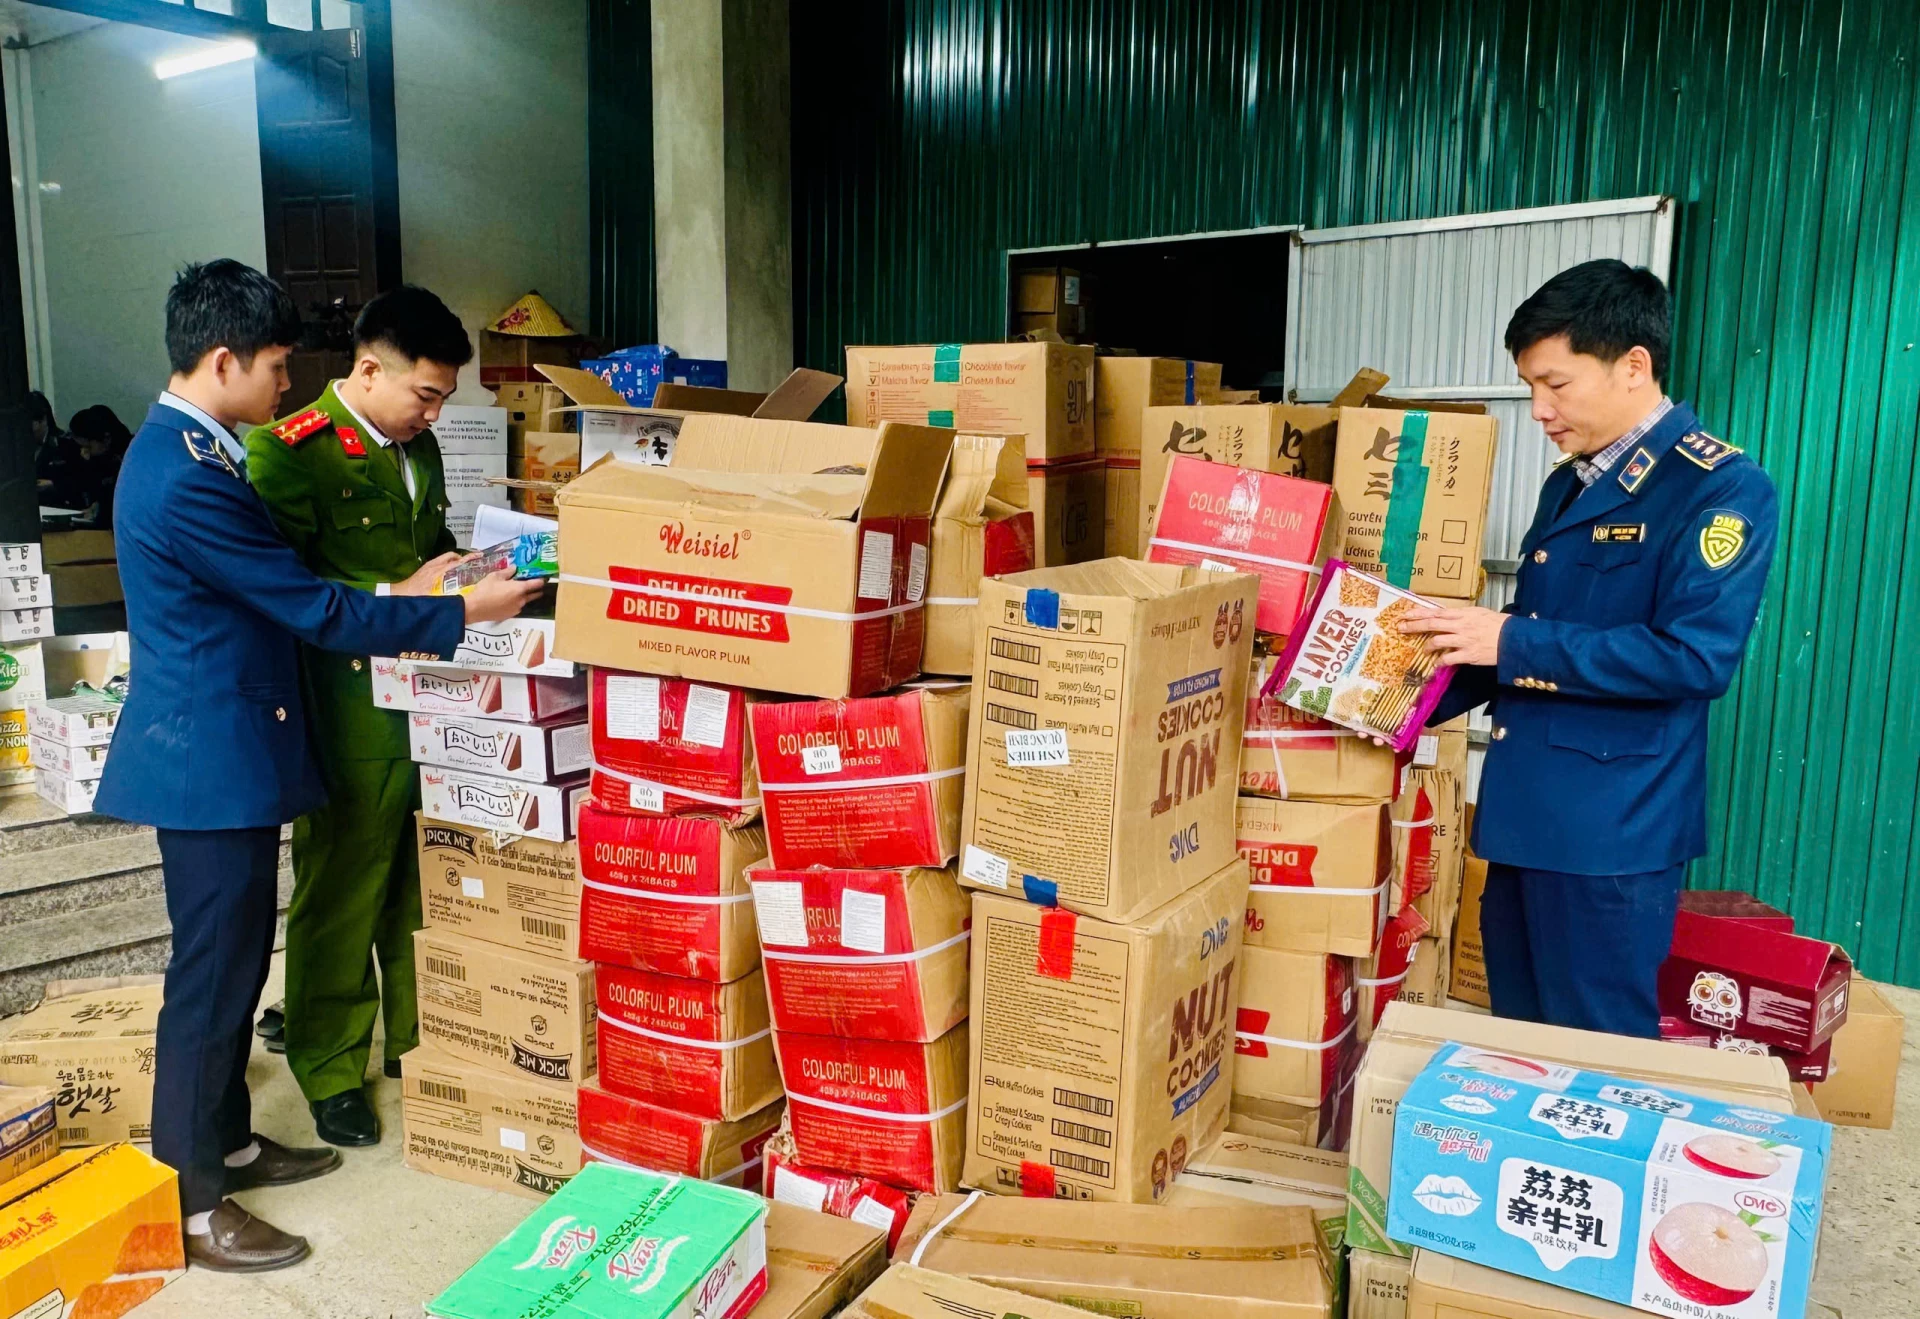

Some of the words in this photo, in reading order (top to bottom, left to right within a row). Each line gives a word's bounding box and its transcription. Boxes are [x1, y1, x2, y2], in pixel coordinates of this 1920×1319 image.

[1261, 507, 1303, 533] PLUM
[1348, 511, 1382, 523] GUYÊN
[1713, 515, 1743, 531] DMS
[1347, 526, 1385, 538] RIGINA
[623, 596, 680, 621] DRIED
[695, 606, 771, 633] PRUNES
[466, 635, 507, 651] いしい
[638, 639, 672, 653] MIXED
[675, 645, 717, 660] FLAVOR
[720, 652, 750, 666] PLUM
[1297, 608, 1353, 679] LAVER
[1325, 617, 1367, 684] COOKIES
[420, 677, 468, 697] おいしい
[1158, 692, 1224, 743] COOKIES
[451, 731, 492, 752] おいしい
[778, 730, 853, 755] COLORFUL
[857, 726, 900, 750] PLUM
[841, 756, 882, 767] 4BAGS
[1039, 749, 1065, 761] ANH
[1151, 727, 1221, 818] NUT
[465, 790, 508, 812] おいしい
[1246, 820, 1283, 832] MIXED
[453, 834, 471, 850] ME
[594, 842, 656, 871] COLORFUL
[659, 852, 697, 876] PLUM
[1240, 847, 1299, 866] DRIED
[608, 982, 665, 1014] COLORFUL
[668, 996, 704, 1020] PLUM
[1398, 990, 1425, 1003] ARE
[1169, 957, 1235, 1063] NUT
[518, 1051, 535, 1070] ME
[1167, 1026, 1227, 1097] COOKIES
[802, 1058, 866, 1085] COLORFUL
[869, 1066, 906, 1090] PLUM
[524, 1170, 545, 1188] ME
[545, 1176, 566, 1194] CK
[1521, 1165, 1592, 1210] 荔荔
[1743, 1195, 1778, 1213] DMC
[1507, 1196, 1608, 1248] 亲牛乳
